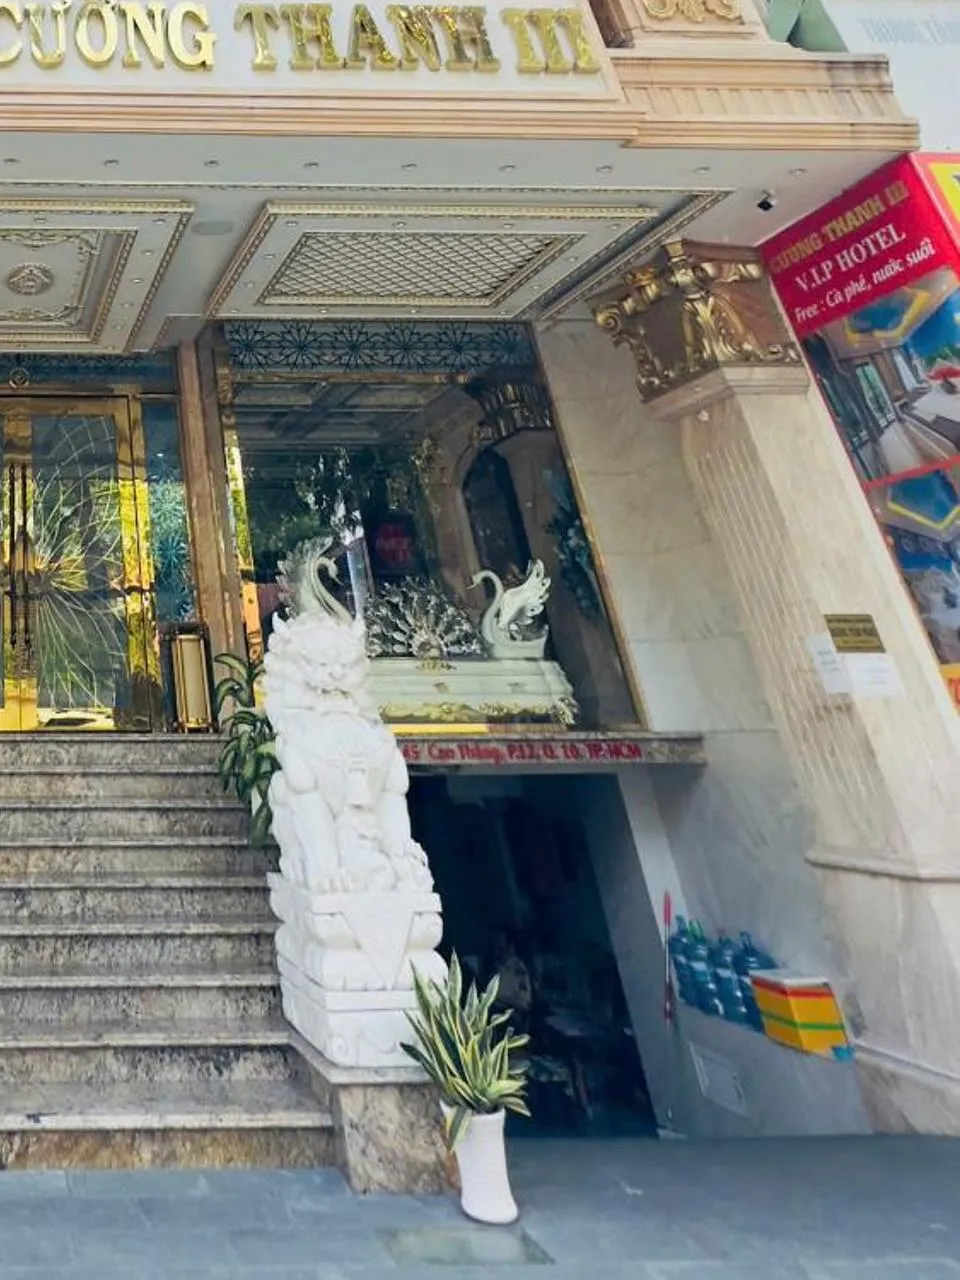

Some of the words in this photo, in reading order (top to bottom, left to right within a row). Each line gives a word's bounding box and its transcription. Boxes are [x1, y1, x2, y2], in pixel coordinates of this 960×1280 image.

[235, 3, 500, 72] THANH
[501, 7, 600, 74] III
[835, 223, 907, 272] HOTEL
